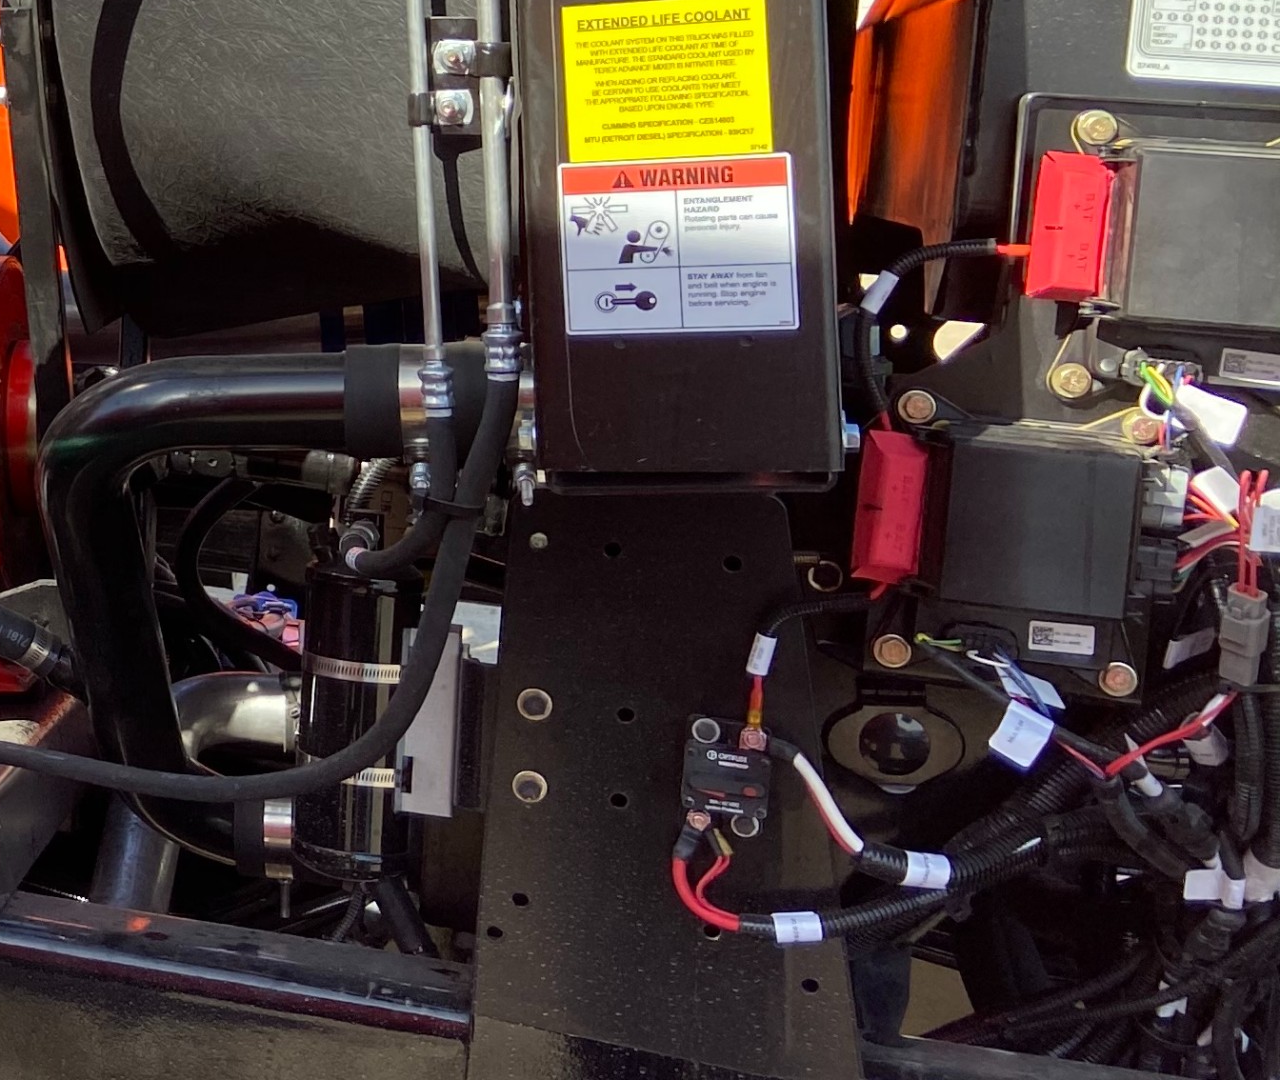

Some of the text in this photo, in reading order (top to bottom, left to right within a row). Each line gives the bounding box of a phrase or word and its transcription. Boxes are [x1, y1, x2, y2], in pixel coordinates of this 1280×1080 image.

[576, 8, 750, 30] EXTENDED LIFE COOLANT
[590, 39, 623, 47] COOLANT
[625, 37, 654, 45] SYSTEM
[685, 33, 710, 41] TRUCK
[729, 30, 753, 38] FILLED
[609, 46, 647, 55] EXTENDED
[664, 43, 699, 51] COOLANT
[632, 55, 645, 63] THE
[647, 53, 685, 62] STANDARD
[687, 50, 721, 59] COOLANT
[640, 166, 733, 187] WARNING
[684, 195, 753, 205] ENTANGLEMENT
[684, 205, 719, 213] HAZARD
[684, 215, 716, 223] Rotating
[718, 214, 737, 223] parts
[755, 212, 778, 220] cause
[684, 224, 718, 233] personal
[720, 290, 737, 298] Stop
